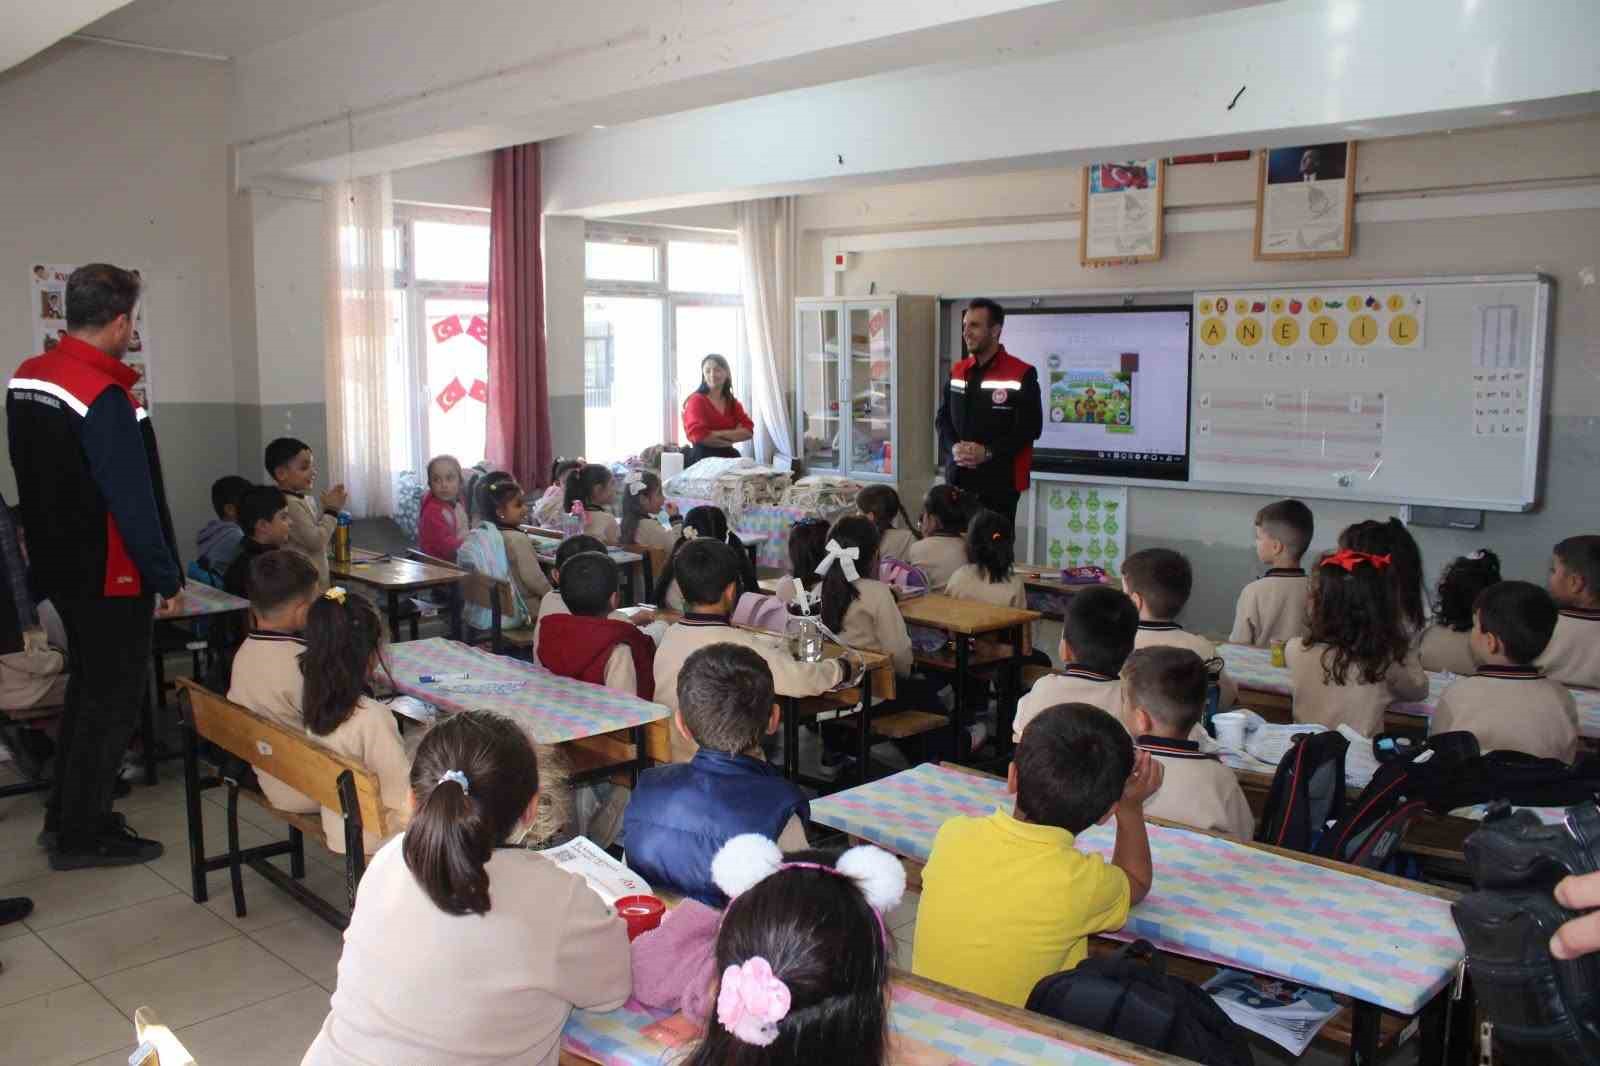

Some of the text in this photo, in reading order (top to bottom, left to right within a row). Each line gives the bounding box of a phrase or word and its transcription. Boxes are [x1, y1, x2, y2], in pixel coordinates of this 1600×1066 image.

[1208, 324, 1219, 339] A
[1242, 324, 1256, 339] N
[1281, 323, 1292, 339] E
[1319, 322, 1329, 337] T
[1398, 319, 1409, 338] L
